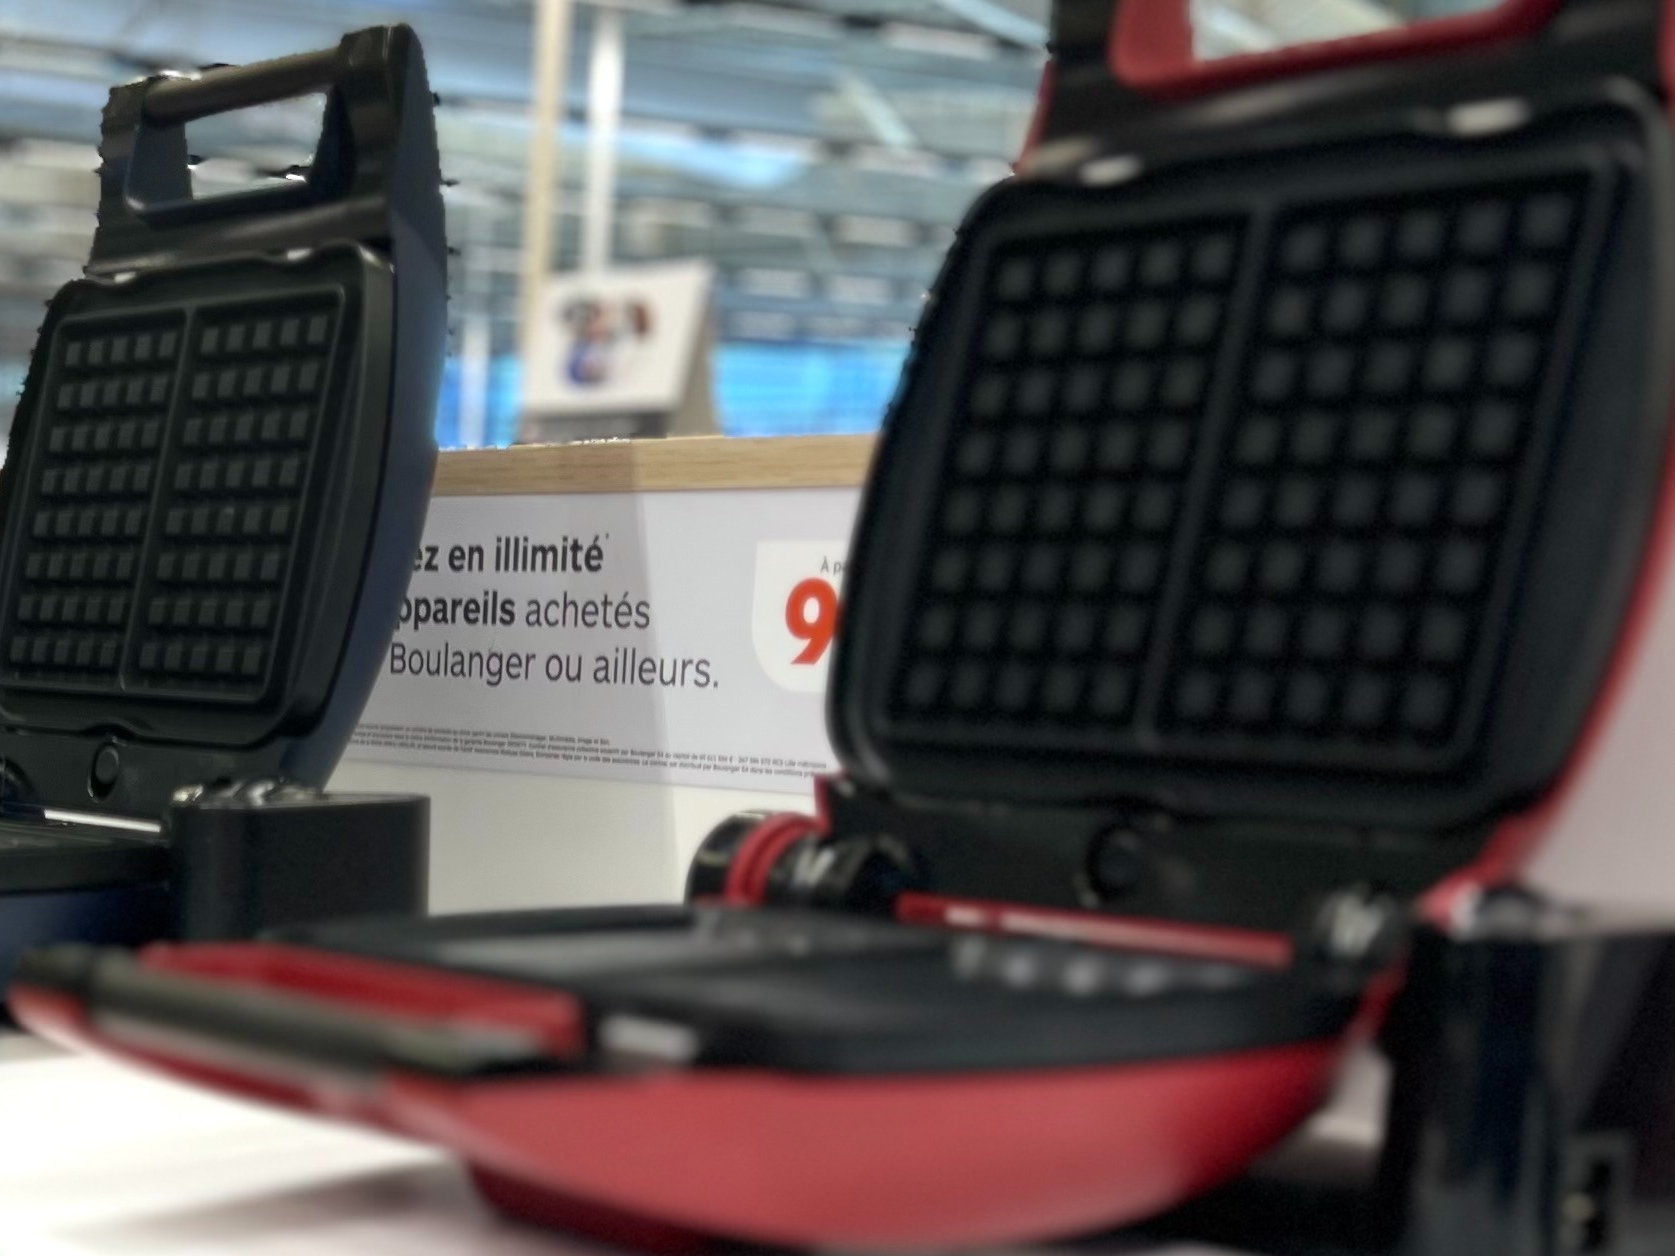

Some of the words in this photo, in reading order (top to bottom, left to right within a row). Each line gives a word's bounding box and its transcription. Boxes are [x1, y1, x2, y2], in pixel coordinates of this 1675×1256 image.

[448, 544, 484, 572] en
[495, 534, 604, 573] illimité
[397, 590, 516, 632] ppareils
[525, 591, 651, 630] achetés
[389, 641, 536, 687] Boulanger
[545, 652, 582, 682] ou
[593, 647, 719, 689] ailleurs.
